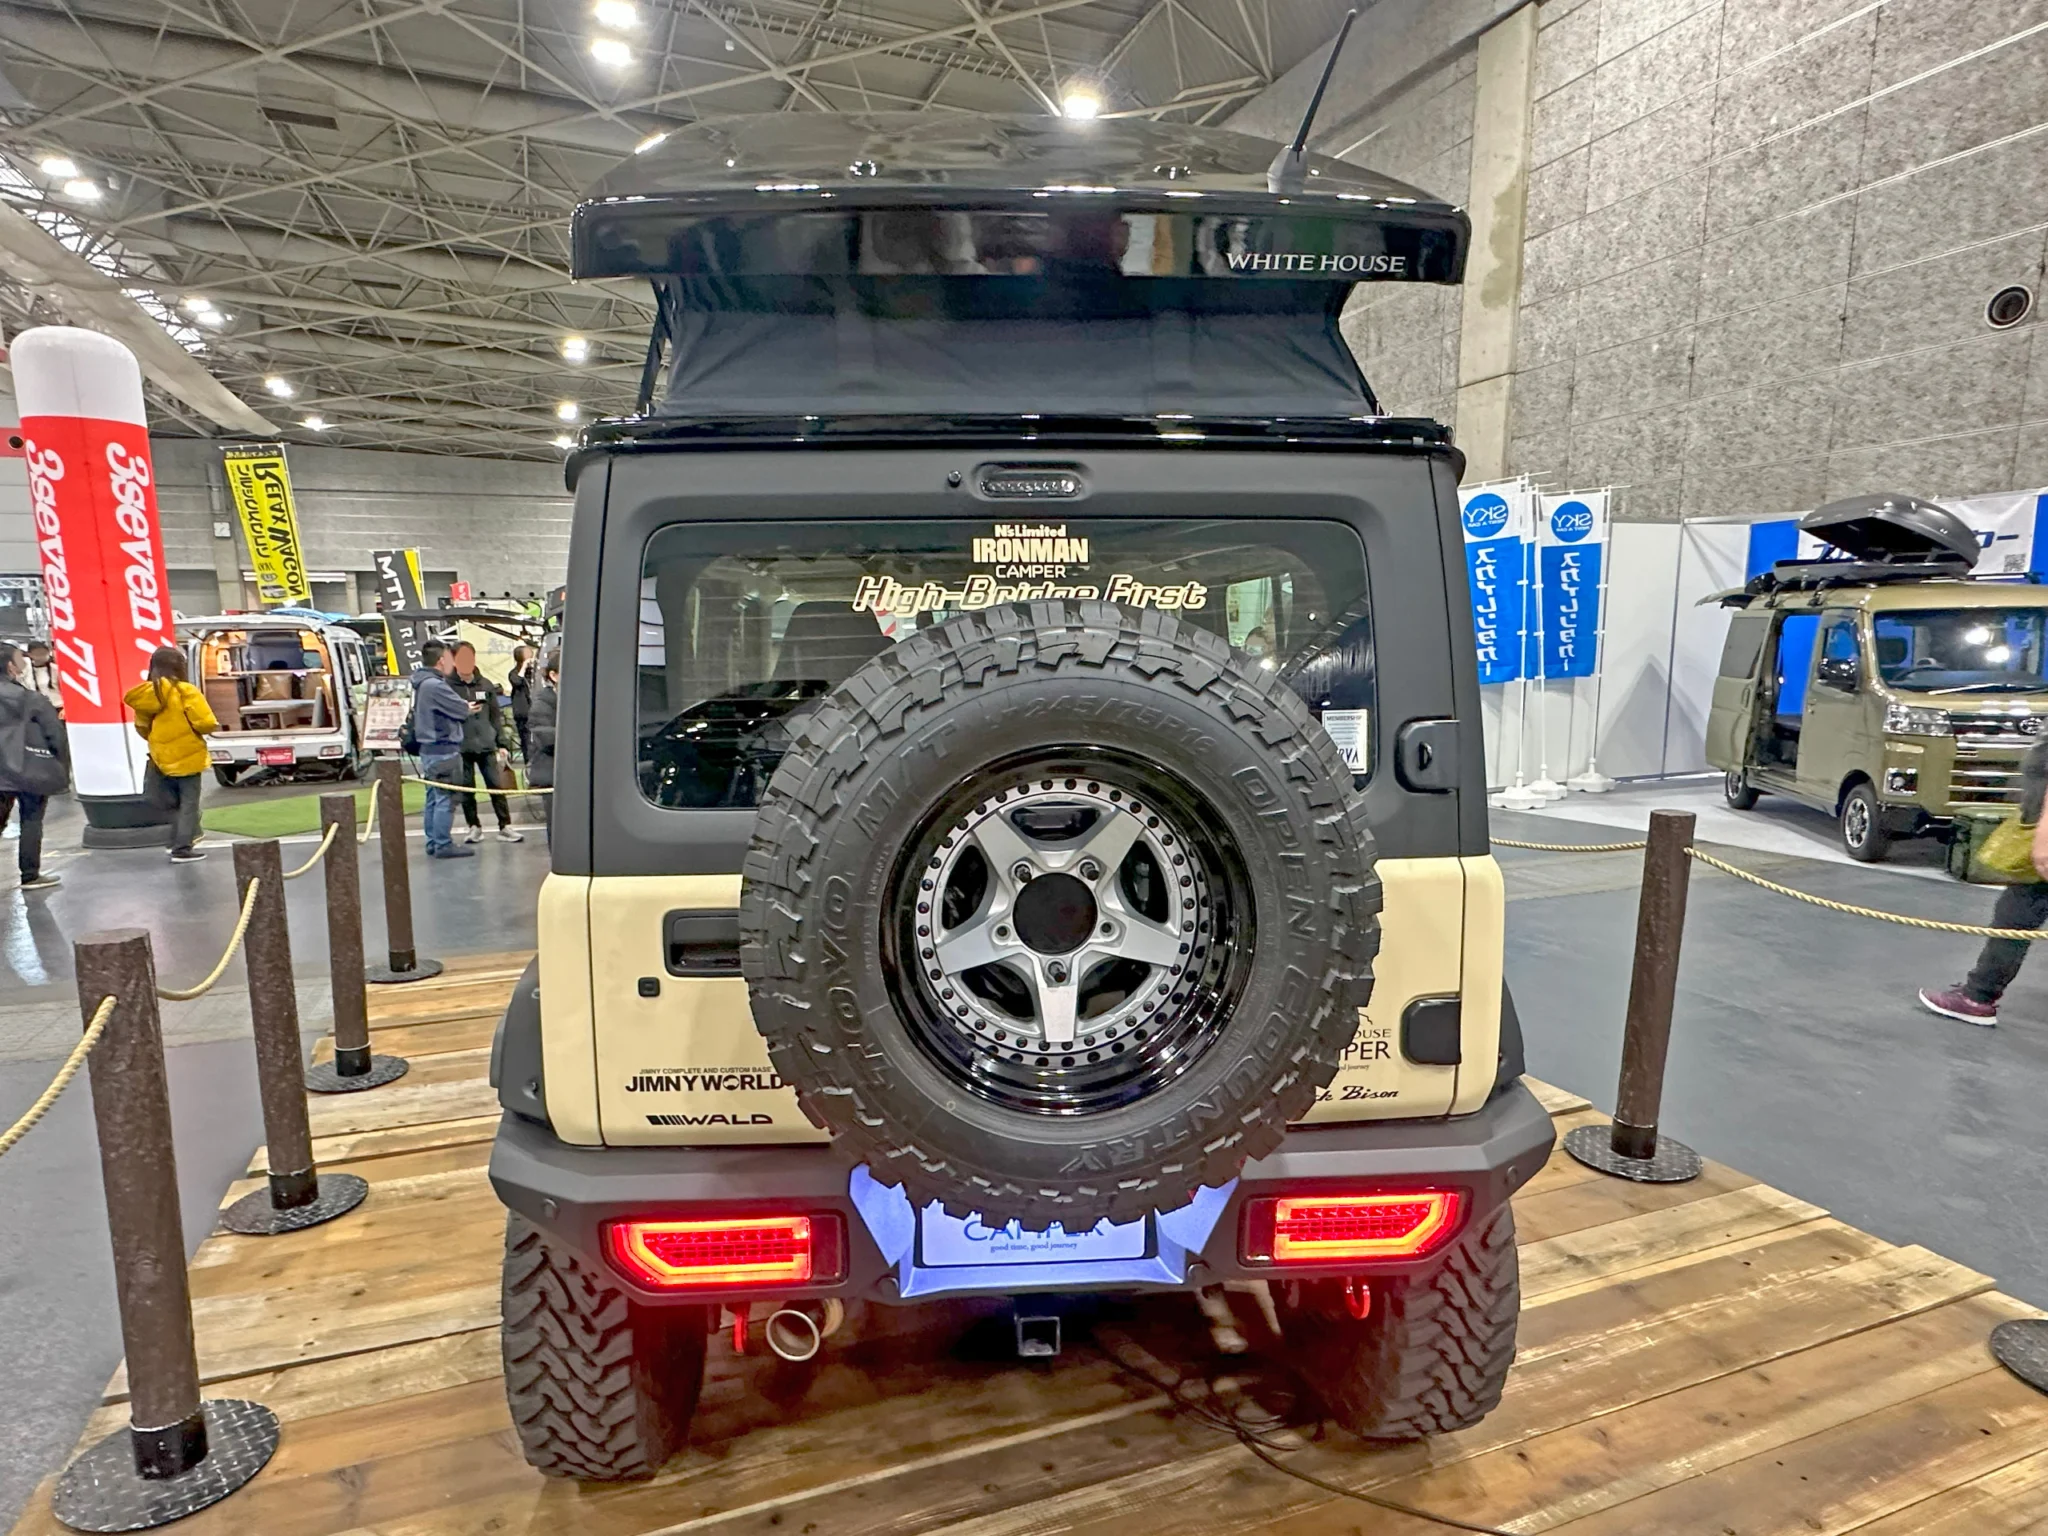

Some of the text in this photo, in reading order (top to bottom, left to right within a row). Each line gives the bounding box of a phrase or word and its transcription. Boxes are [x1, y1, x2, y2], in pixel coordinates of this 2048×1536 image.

[1226, 252, 1406, 273] WHITE HOUSE
[973, 538, 1089, 563] IRONMAN
[995, 564, 1067, 579] CAMPER
[1103, 574, 1208, 610] First
[1232, 764, 1317, 948] OPEN
[1353, 1028, 1392, 1039] OUSE
[1340, 1041, 1391, 1061] PER
[662, 1067, 702, 1075] COMPLETE
[720, 1066, 751, 1074] CUSTOM
[1340, 1085, 1400, 1101] Bison
[682, 1114, 773, 1126] WALD
[990, 1243, 1009, 1253] good
[1030, 1241, 1049, 1252] good
[1049, 1242, 1077, 1252] journey
